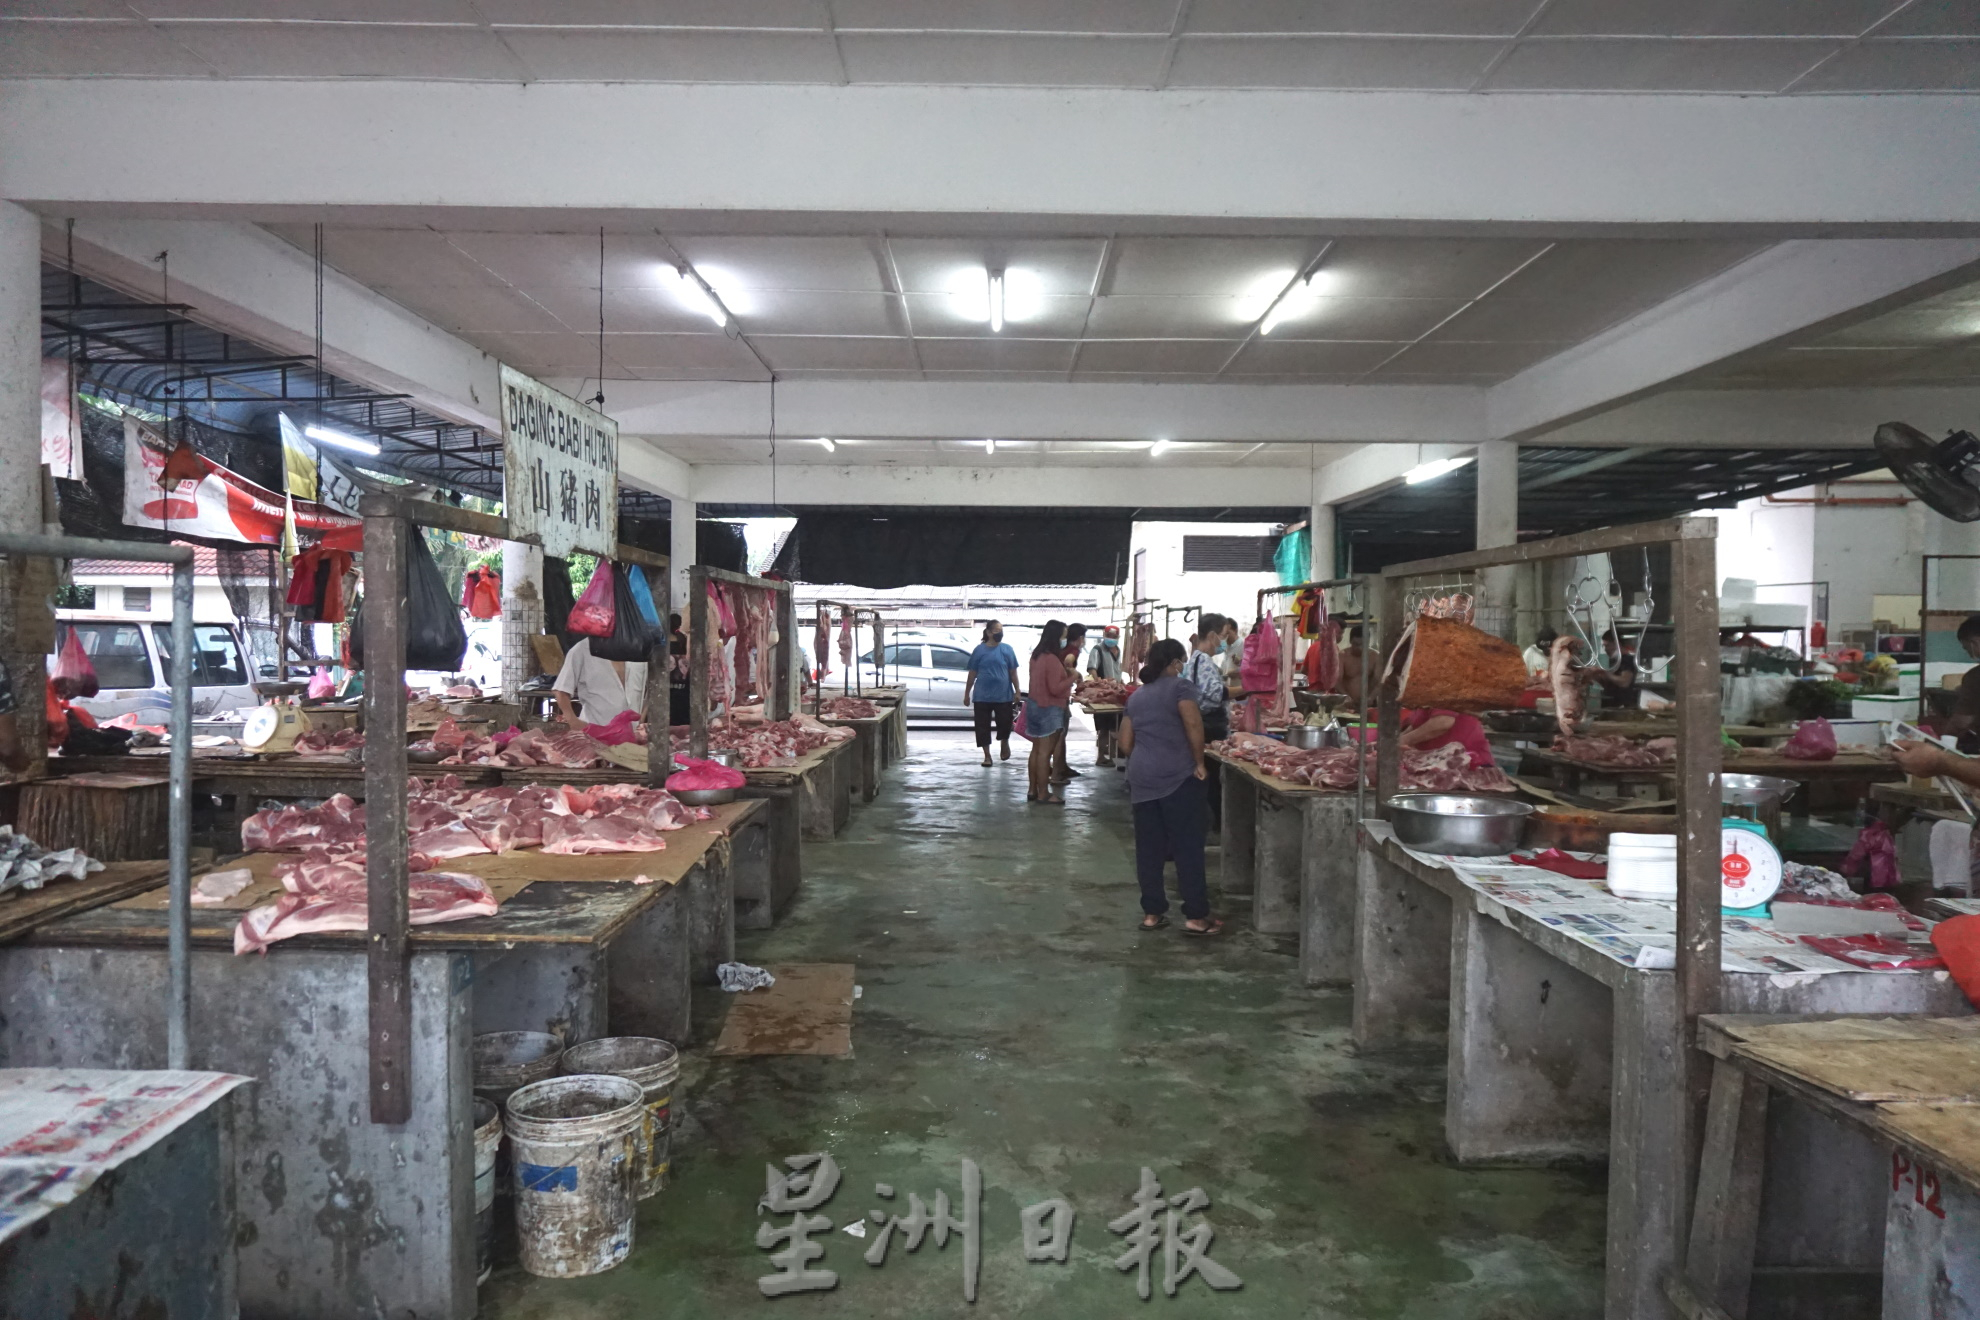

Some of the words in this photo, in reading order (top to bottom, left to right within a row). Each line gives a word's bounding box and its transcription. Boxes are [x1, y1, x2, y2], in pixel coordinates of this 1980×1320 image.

[508, 385, 556, 449] DAGING
[557, 410, 583, 461] BABI
[584, 423, 614, 474] HUTAN
[530, 457, 601, 532] 山豬肉
